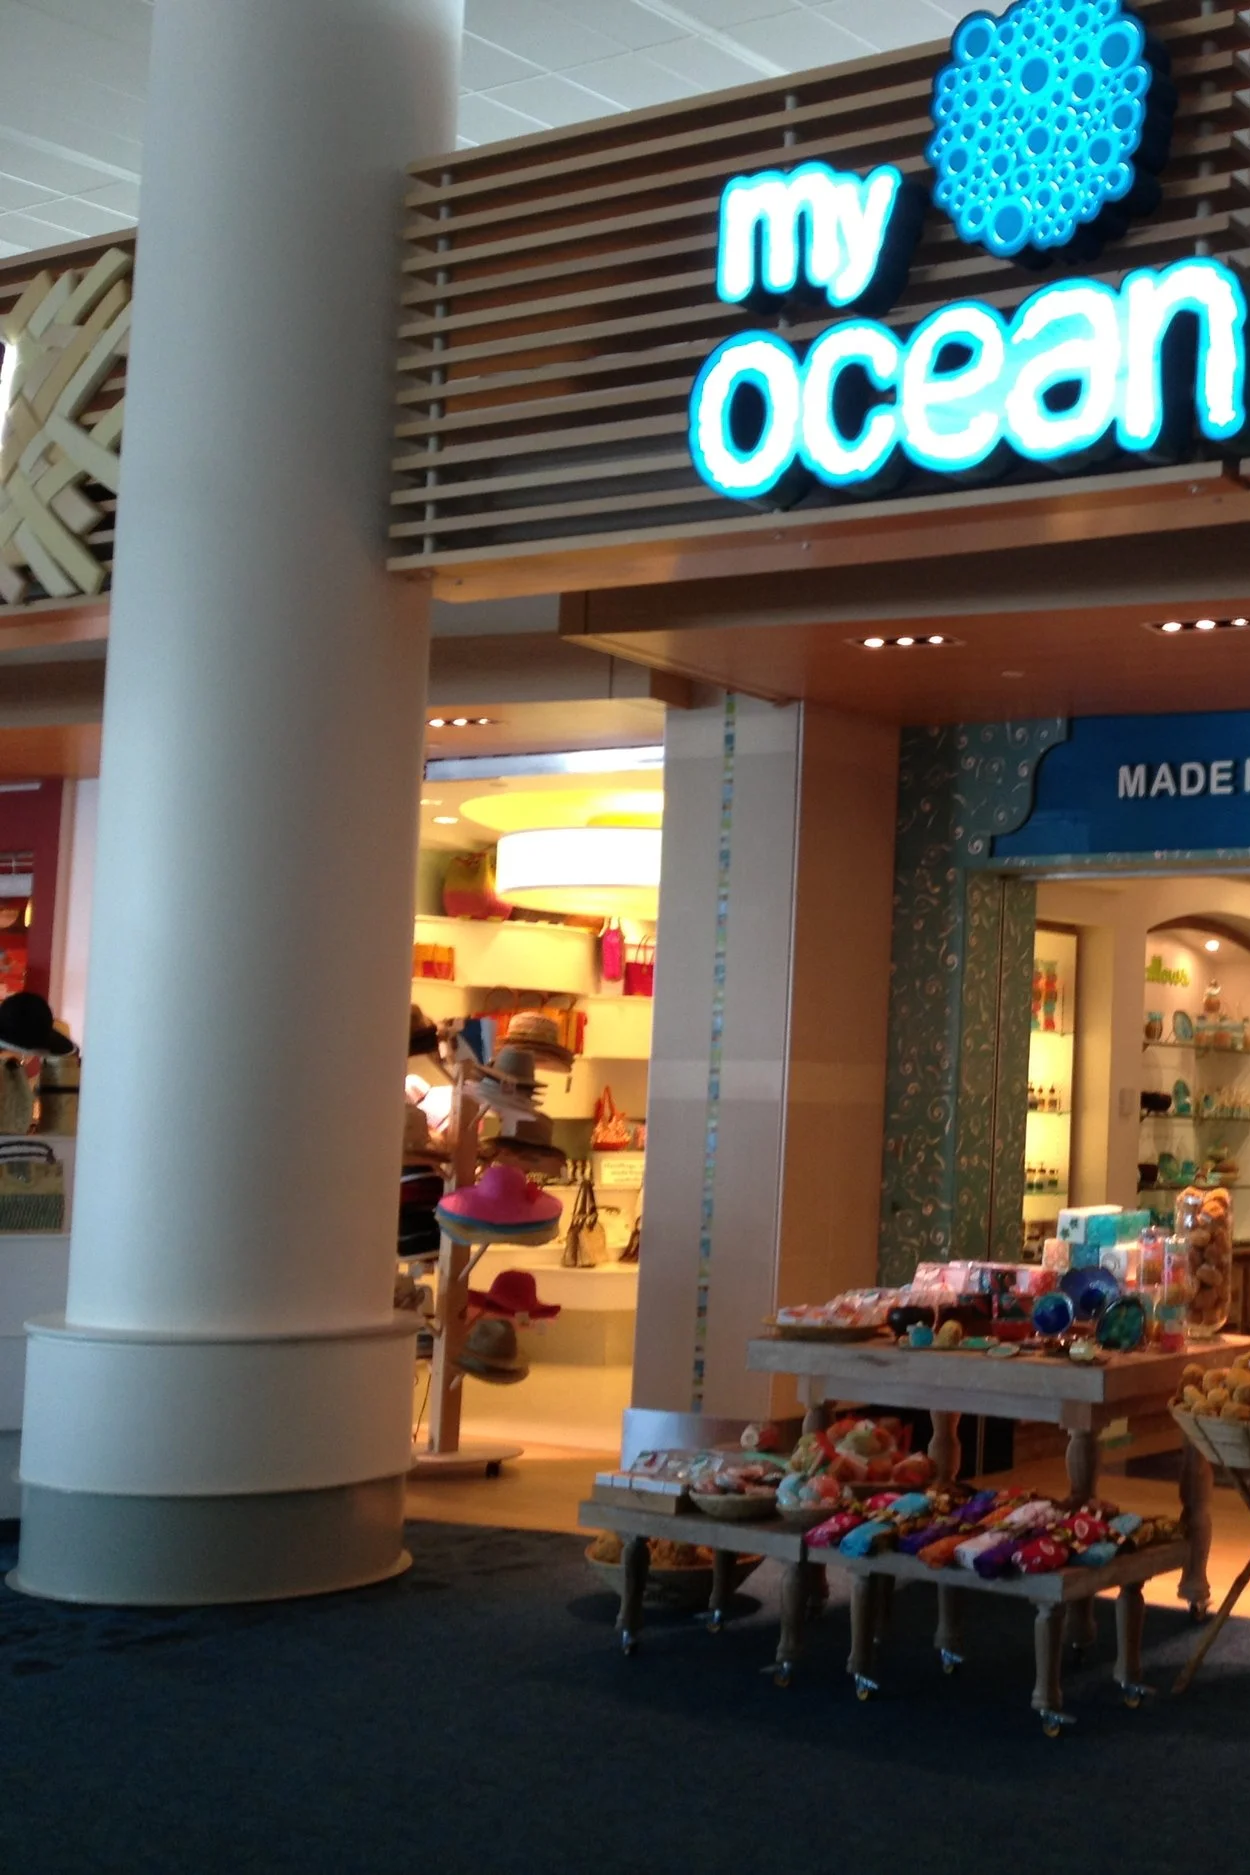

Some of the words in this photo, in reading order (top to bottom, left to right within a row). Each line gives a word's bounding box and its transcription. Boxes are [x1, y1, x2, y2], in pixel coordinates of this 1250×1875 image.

[717, 161, 901, 306] my
[689, 257, 1246, 498] ocean
[1118, 760, 1234, 798] MADE
